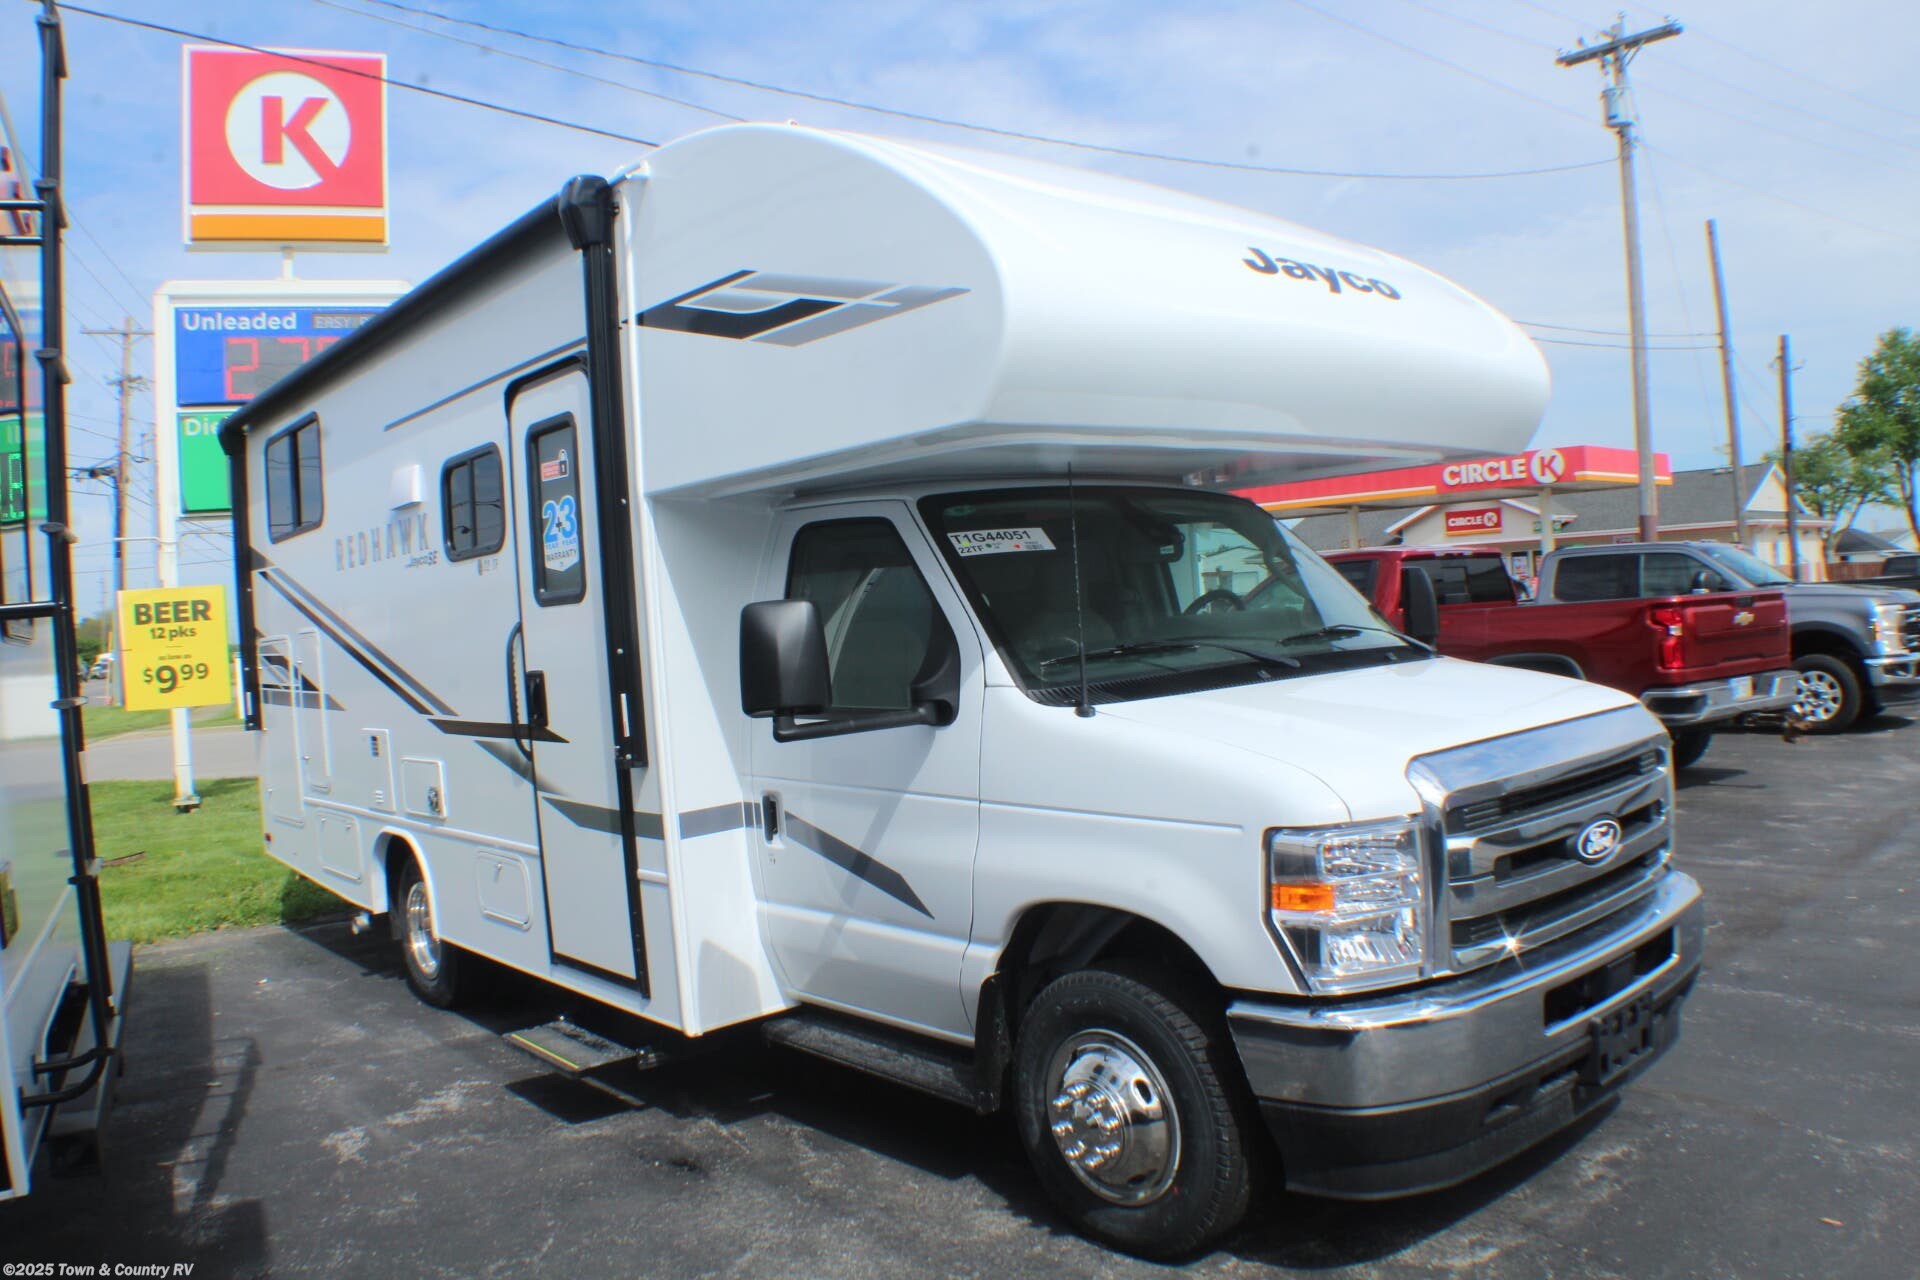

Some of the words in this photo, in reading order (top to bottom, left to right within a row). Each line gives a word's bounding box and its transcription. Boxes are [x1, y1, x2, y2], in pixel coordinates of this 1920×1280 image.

[260, 94, 343, 184] K
[1242, 246, 1401, 300] Jayco
[183, 312, 297, 330] Unleaded
[1442, 458, 1528, 486] CIRCLE
[1448, 515, 1483, 527] CIRCLE
[336, 512, 430, 572] REDHAWK
[950, 530, 1031, 545] T1G44051
[134, 599, 211, 625] BEER
[150, 627, 166, 639] 12
[168, 626, 197, 641] pks
